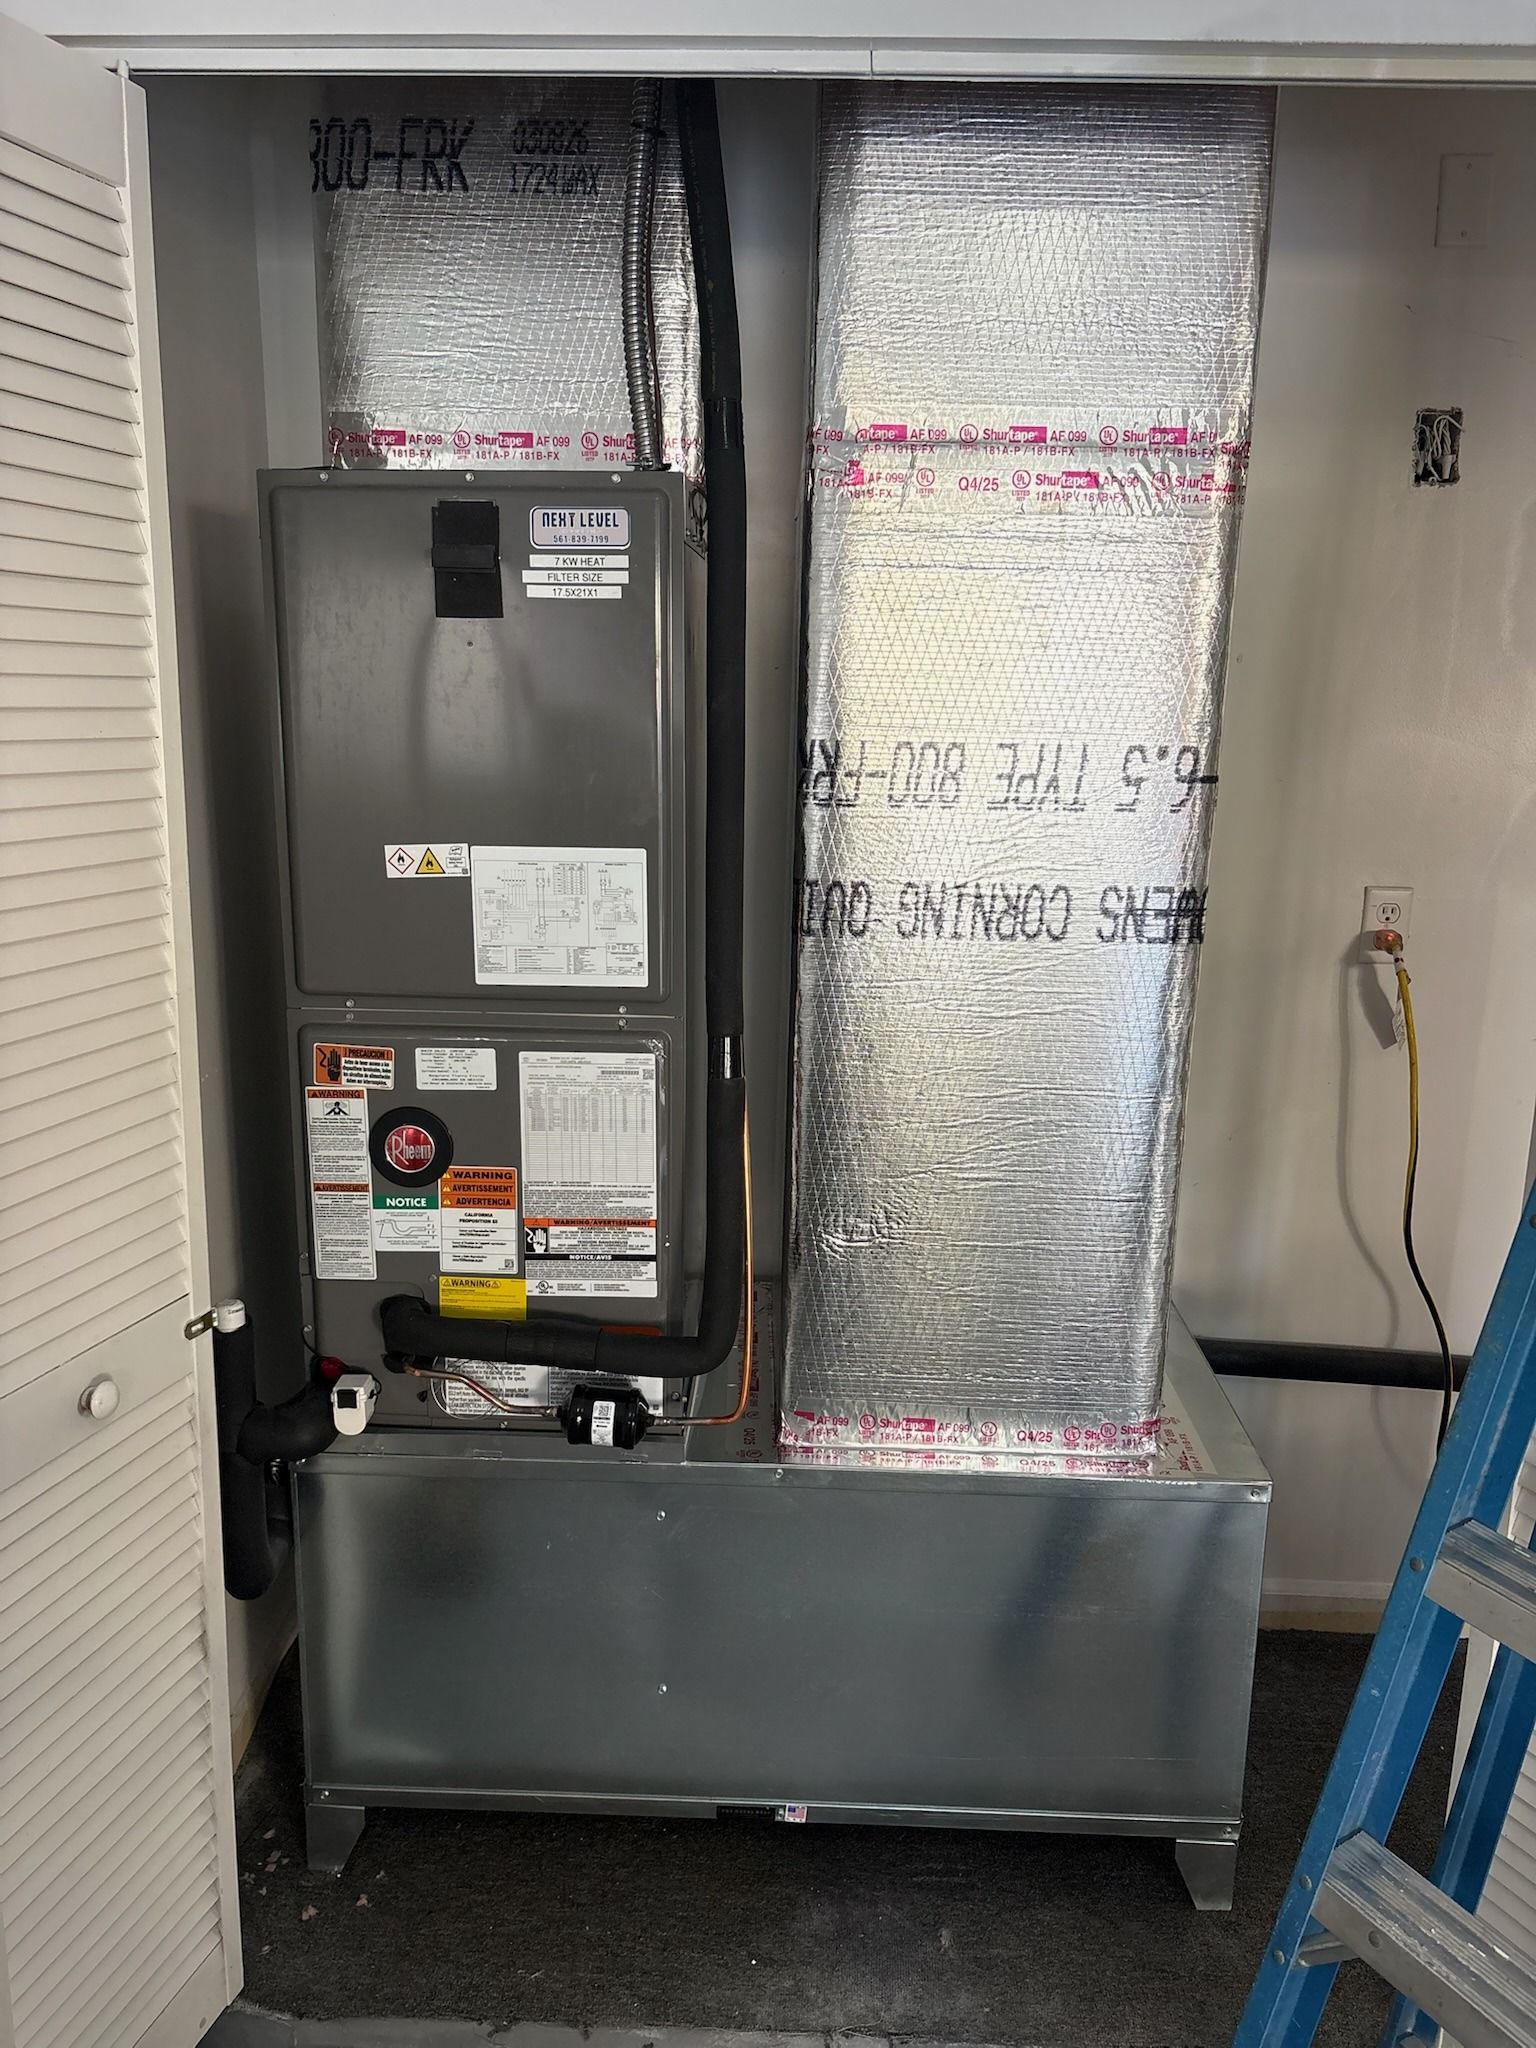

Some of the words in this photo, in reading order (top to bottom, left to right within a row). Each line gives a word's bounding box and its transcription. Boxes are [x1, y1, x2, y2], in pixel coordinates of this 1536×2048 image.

[409, 434, 424, 445] AF
[425, 434, 443, 446] 099
[910, 429, 925, 440] AF
[983, 426, 1047, 443] Shurtape
[1050, 430, 1066, 442] AF
[1068, 430, 1087, 442] 099
[1122, 427, 1188, 445] Shurtape
[475, 432, 534, 449] Shurtape
[536, 436, 550, 447] AF
[552, 436, 570, 447] 099
[477, 450, 510, 460] 181A-P
[520, 451, 560, 461] 181B-FX
[984, 446, 1020, 456] 181A-P
[1031, 446, 1075, 456] 181B-FX
[885, 472, 904, 483] 099
[1035, 471, 1099, 489] Shurtape
[958, 476, 1000, 492] Q4/25
[542, 512, 576, 528] NEXT
[580, 512, 619, 528] LEVEL
[555, 557, 560, 567] 7
[562, 557, 578, 567] KW
[580, 557, 606, 567] HEAT
[547, 572, 580, 582] FILTER
[582, 572, 603, 582] SIZE
[552, 588, 598, 598] 17.5X21X1
[986, 743, 1088, 811] TYPE
[898, 880, 1075, 944] CORNING
[319, 1090, 360, 1098] WARNING
[389, 1129, 433, 1166] Rheem
[453, 1170, 513, 1181] WARNING
[453, 1183, 513, 1193] AVERTISSEMENT
[386, 1197, 427, 1207] NOTICE
[455, 1197, 512, 1206] ADVERTENCIA
[553, 1219, 651, 1227] WARNING/AVERTISSEMENT
[451, 1279, 491, 1288] WARNING
[816, 1416, 831, 1425] AF
[832, 1416, 849, 1427] 099
[879, 1418, 936, 1432] Shurtape
[938, 1423, 951, 1432] AF
[953, 1423, 970, 1433] 099
[880, 1432, 912, 1441] 181A-P
[1017, 1430, 1053, 1443] Q4/25
